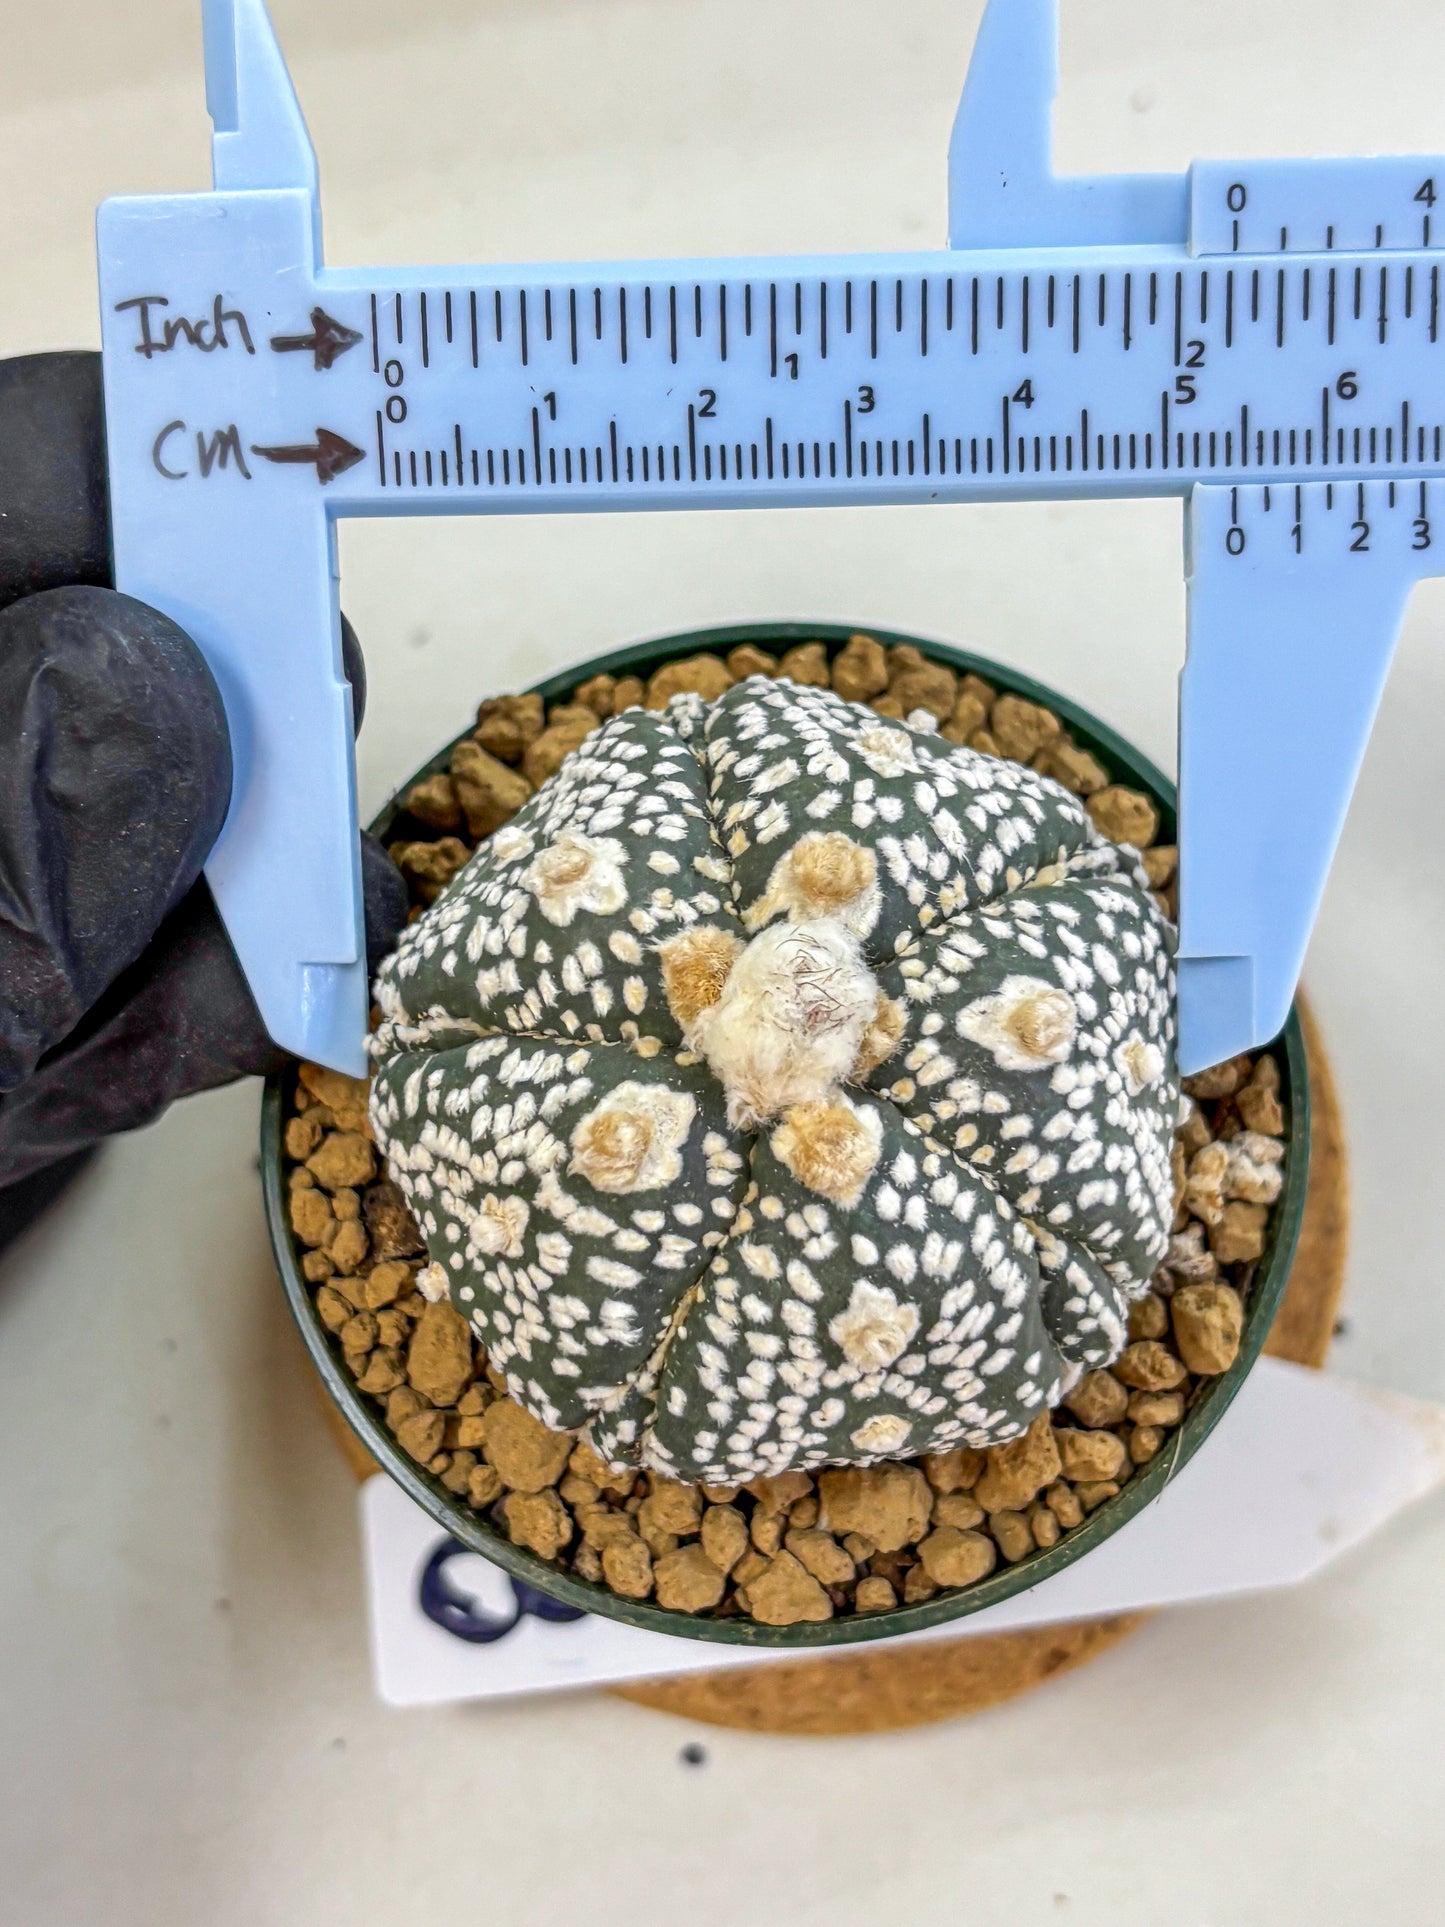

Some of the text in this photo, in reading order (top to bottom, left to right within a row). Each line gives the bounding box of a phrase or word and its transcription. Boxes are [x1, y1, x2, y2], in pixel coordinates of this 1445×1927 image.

[1227, 178, 1437, 212] 0 4
[114, 294, 256, 359] Inch
[384, 340, 1206, 388] 0 1 2
[385, 371, 1359, 424] 0 1 2 3 4 5 6
[1225, 519, 1432, 556] 0 1 2 3
